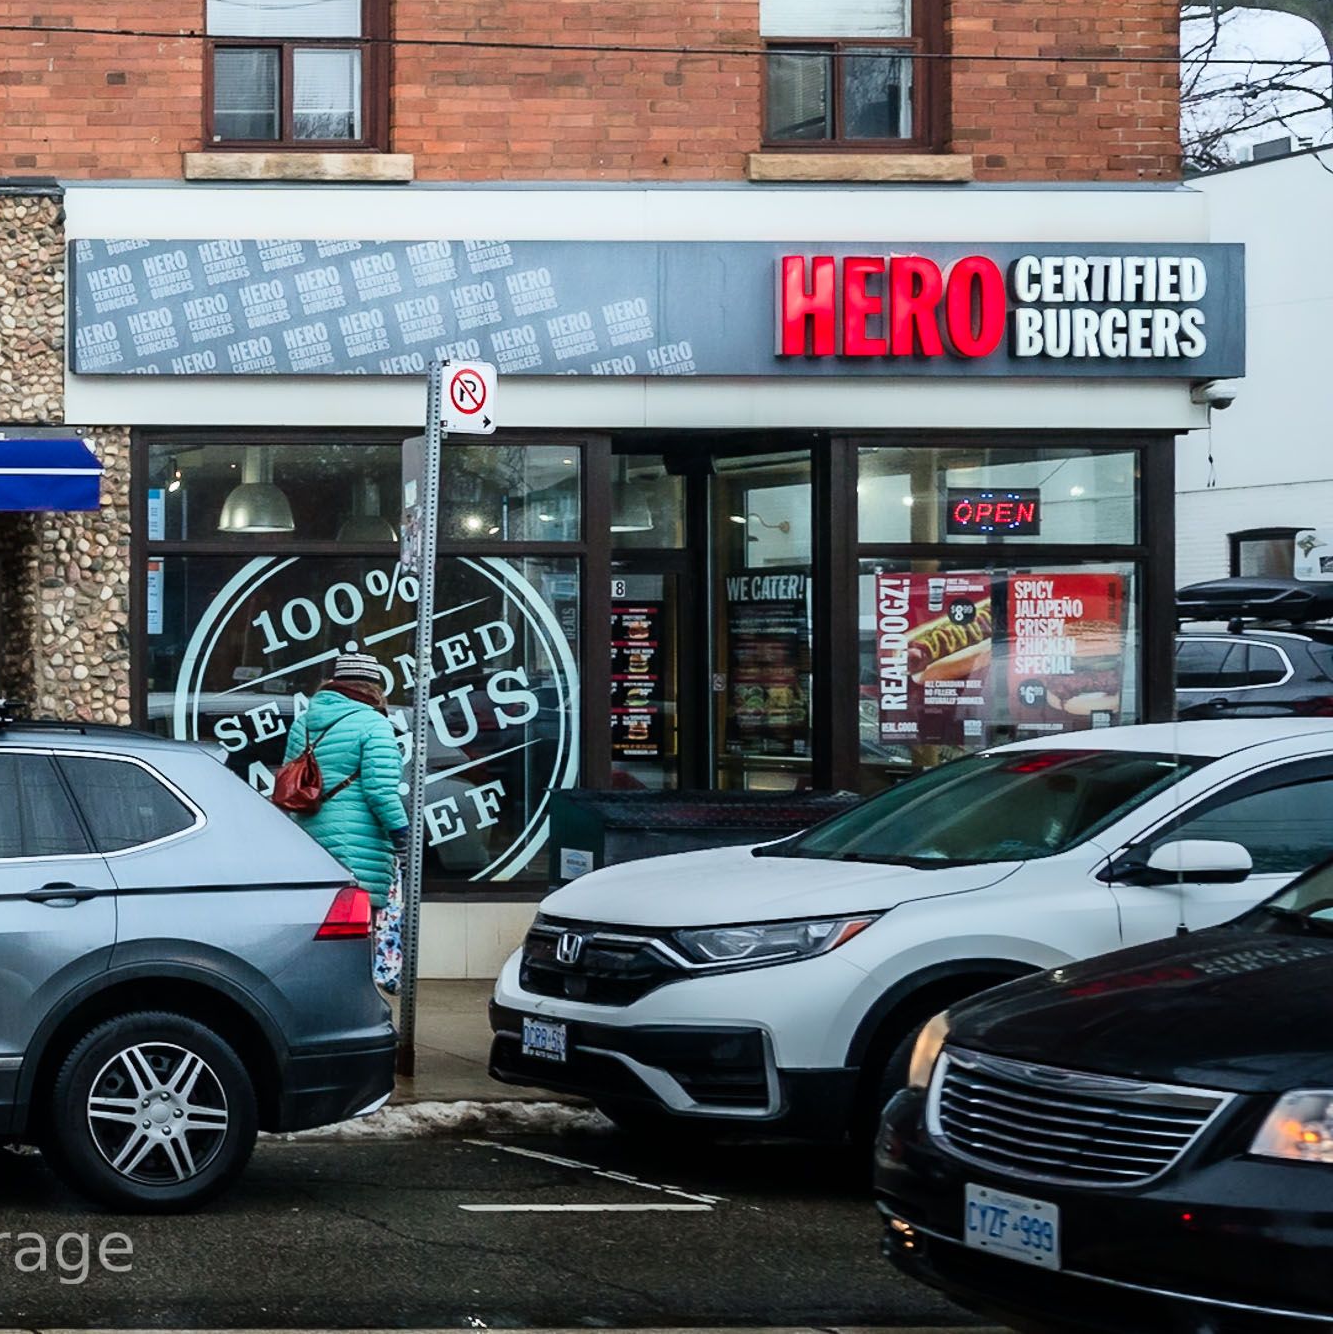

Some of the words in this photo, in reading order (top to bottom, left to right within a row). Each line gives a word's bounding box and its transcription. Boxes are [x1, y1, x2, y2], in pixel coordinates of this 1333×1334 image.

[142, 250, 187, 277] HERO
[350, 252, 395, 279] HERO
[87, 265, 132, 291] HERO
[294, 266, 339, 293] HERO
[506, 268, 551, 294] HERO
[239, 279, 284, 306] HERO
[450, 281, 495, 308] HERO
[183, 294, 228, 320] HERO
[394, 295, 439, 322] HERO
[602, 298, 647, 324] HERO
[778, 255, 1006, 358] HERO
[1014, 255, 1207, 303] CERTIFIED
[127, 307, 172, 334] HERO
[338, 308, 384, 335] HERO
[547, 311, 592, 338] HERO
[1015, 308, 1207, 359] BURGERS
[283, 322, 328, 349] HERO
[490, 325, 536, 352] HERO
[228, 336, 272, 363] HERO
[647, 341, 693, 369] HERO
[954, 500, 1036, 524] OPEN
[726, 577, 749, 601] WE
[751, 575, 805, 600] CATER!
[1014, 580, 1054, 599] SPICY
[252, 561, 421, 655] 100%
[1014, 597, 1083, 618] JALAPEÑO
[1014, 618, 1066, 637] CRISPY
[1015, 637, 1076, 655] CHICKEN
[1015, 655, 1075, 675] SPECIAL
[1020, 1215, 1053, 1252] 999
